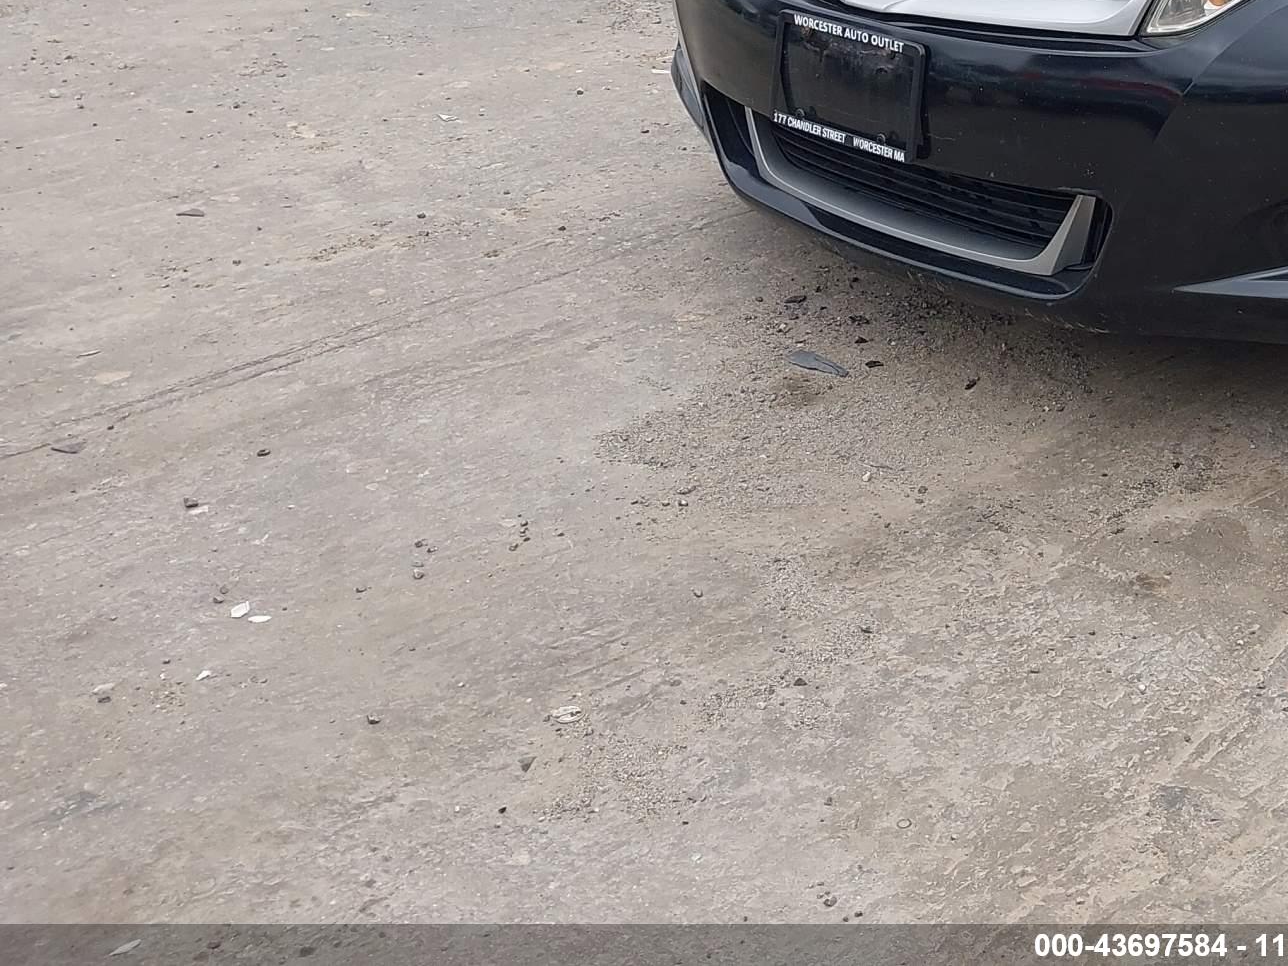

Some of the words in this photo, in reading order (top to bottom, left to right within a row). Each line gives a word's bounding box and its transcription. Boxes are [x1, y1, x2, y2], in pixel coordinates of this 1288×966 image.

[793, 13, 843, 37] WORCESTER
[844, 26, 869, 43] AUTO
[871, 35, 905, 53] OUTLET
[773, 112, 787, 124] 177
[787, 115, 822, 136] CHANDLER
[822, 128, 846, 144] STREET
[852, 136, 893, 159] WORCESTER
[893, 149, 905, 163] MA
